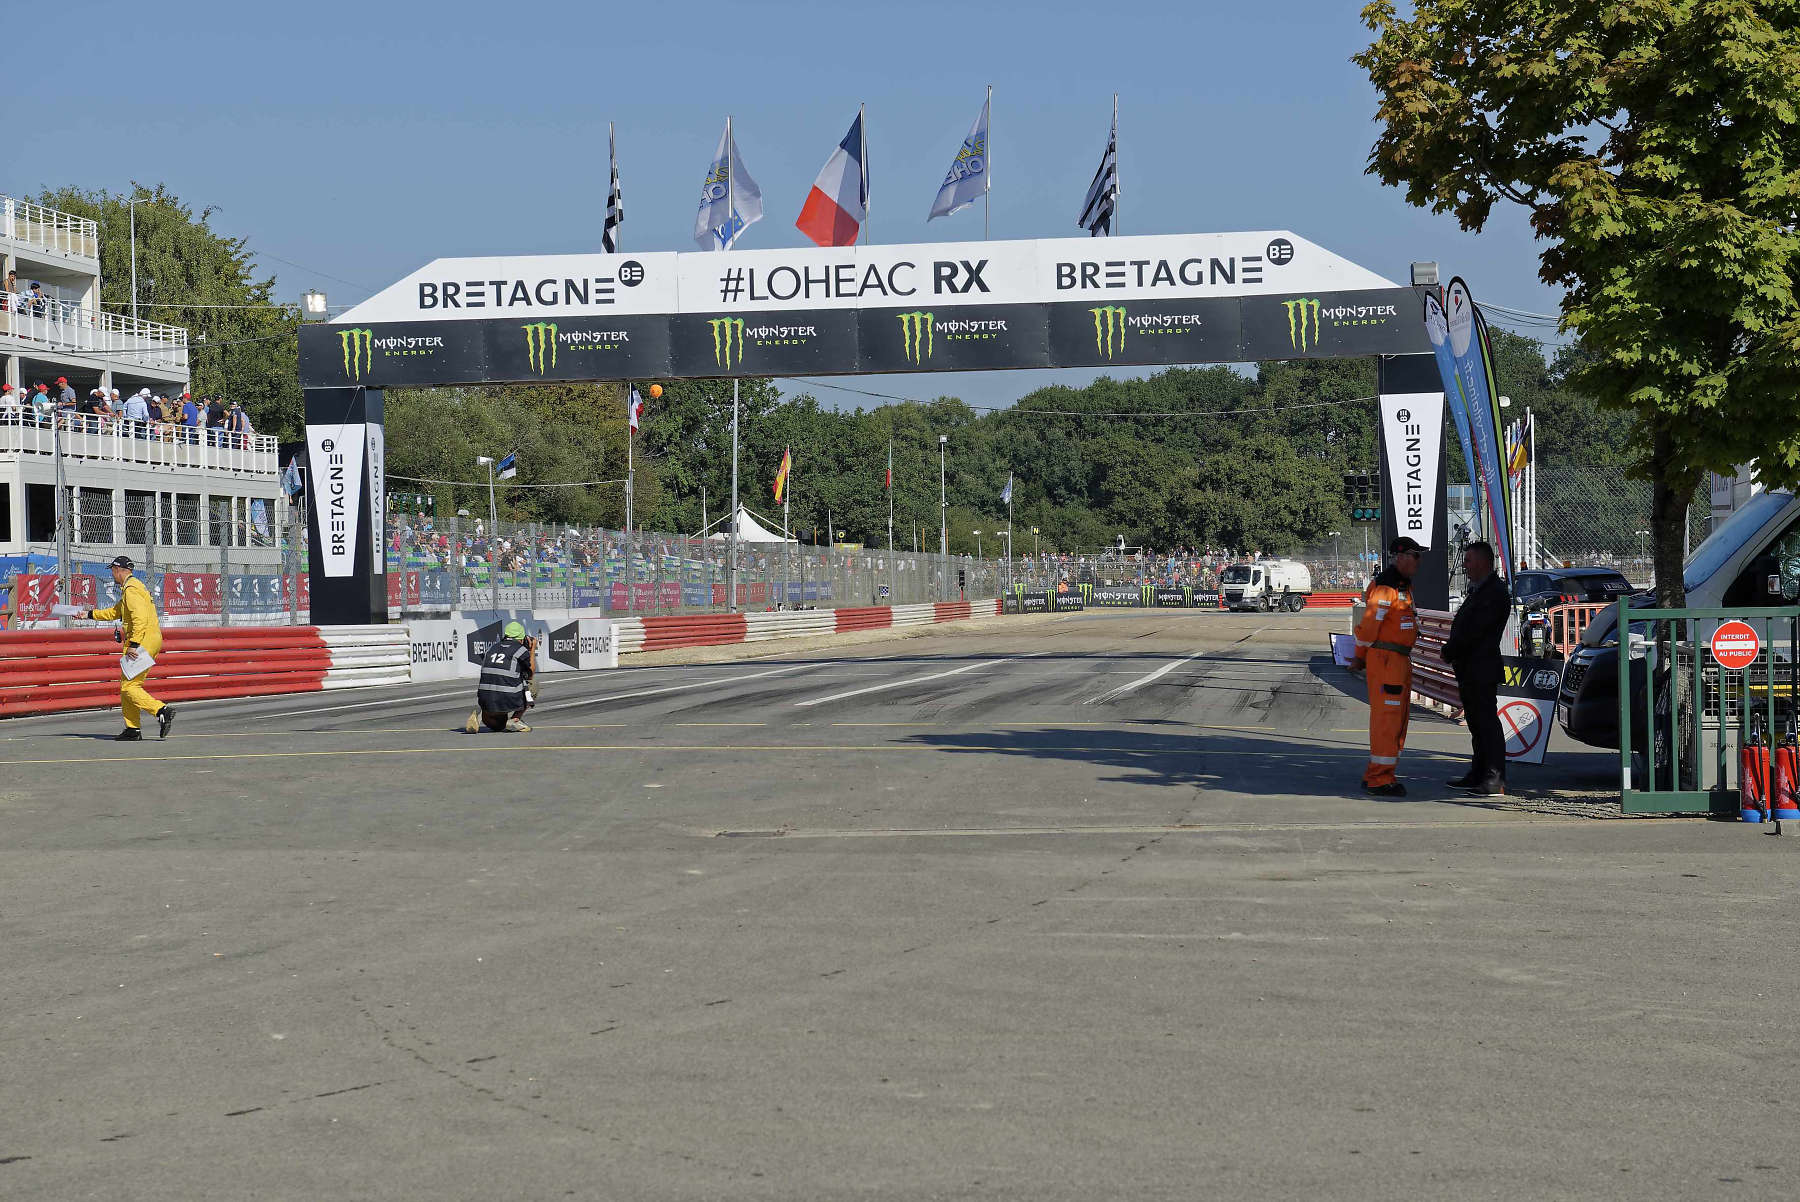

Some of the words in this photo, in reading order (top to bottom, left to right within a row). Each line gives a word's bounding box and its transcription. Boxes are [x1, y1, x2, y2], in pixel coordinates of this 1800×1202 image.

[1269, 244, 1291, 259] BE
[620, 267, 642, 281] BE
[1056, 255, 1263, 290] BRETAGNE
[719, 261, 917, 303] #LOHEAC
[933, 259, 991, 295] RX
[419, 277, 615, 310] BRETAGNE
[1322, 303, 1397, 319] MONSTER
[936, 318, 1008, 333] MONSTER
[1128, 312, 1202, 328] MONSTER
[1334, 318, 1386, 327] ENERGY
[559, 329, 630, 343] MONSTER
[746, 324, 817, 339] MONSTER
[1139, 327, 1191, 335] ENERGY
[374, 335, 444, 350] MONSTER
[1405, 424, 1423, 530] BRETAGNE
[329, 453, 346, 556] BRETAGNE
[1094, 591, 1139, 600] MONSTER
[412, 641, 453, 663] BRETAGNE
[490, 653, 506, 664] 12
[1535, 673, 1557, 686] FIA
